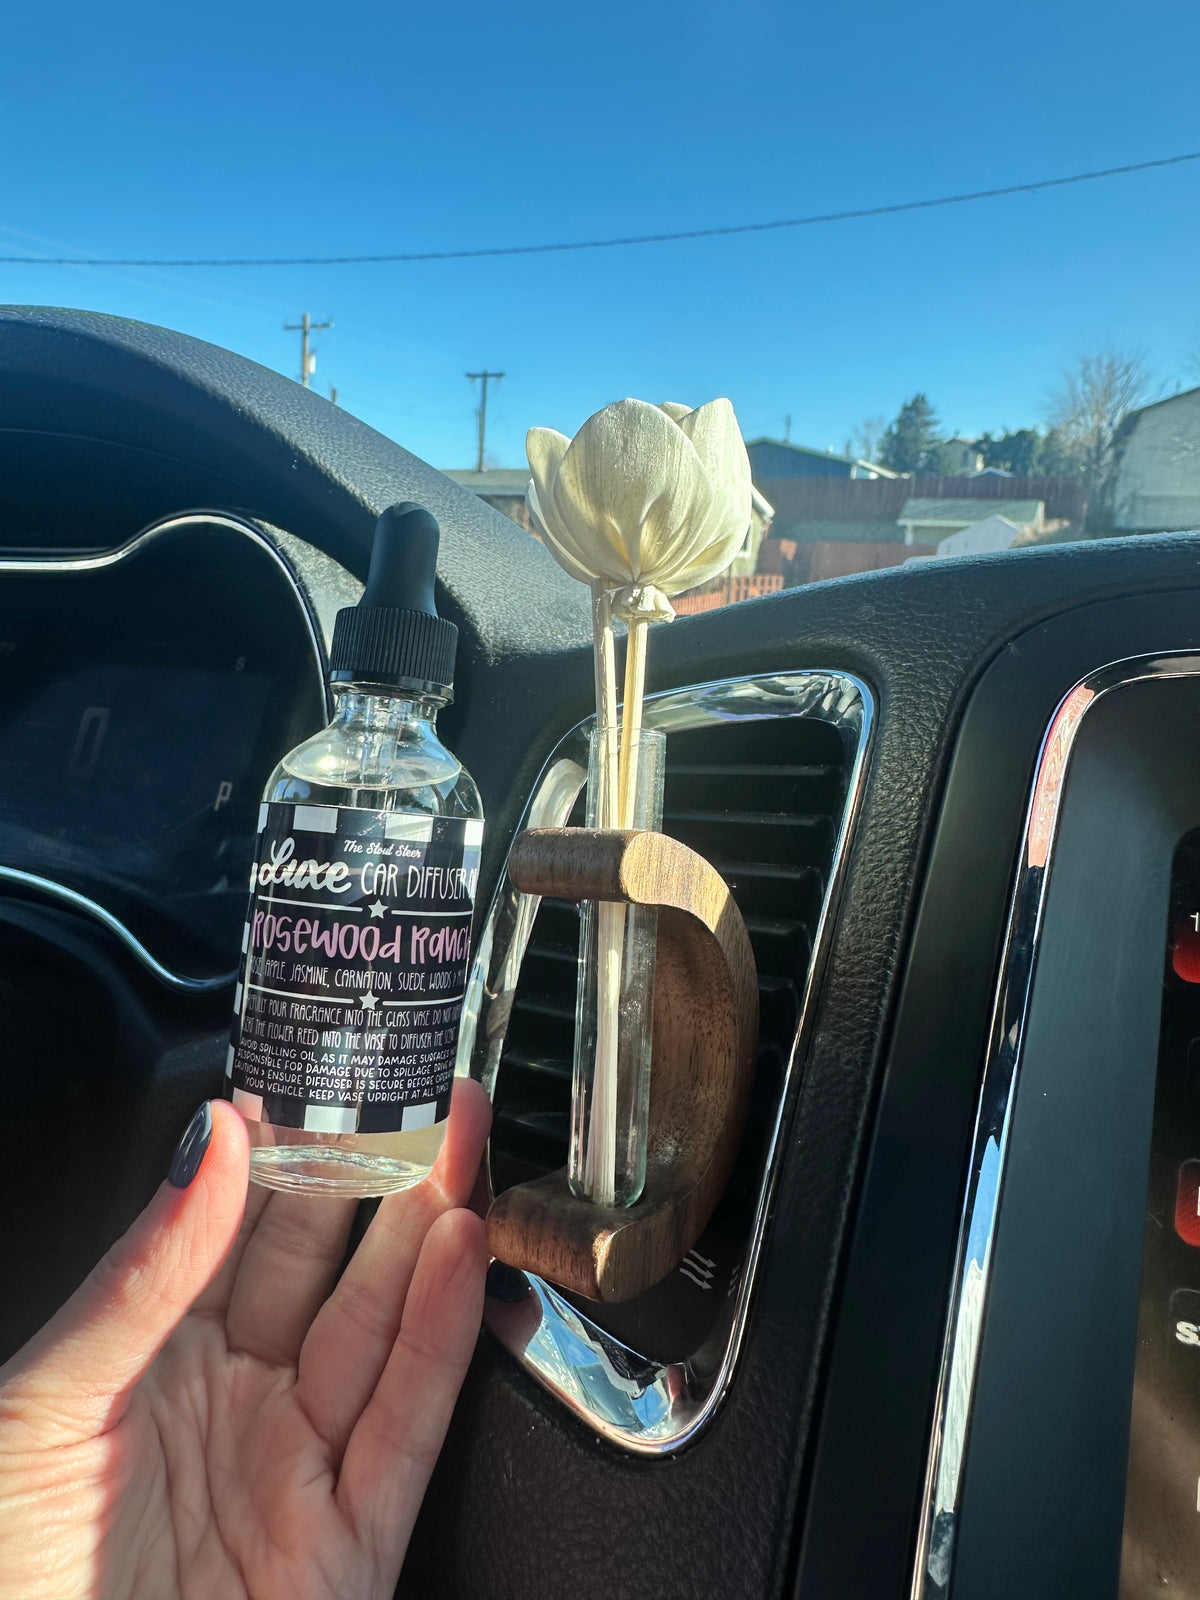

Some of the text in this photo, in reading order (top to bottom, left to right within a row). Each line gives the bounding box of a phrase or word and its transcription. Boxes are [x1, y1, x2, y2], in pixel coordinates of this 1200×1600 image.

[214, 780, 234, 811] P
[343, 839, 421, 858] The Stout Steer
[360, 861, 399, 897] CAR
[406, 865, 467, 899] DIFFUSER
[289, 962, 330, 988] JASMINE,
[334, 968, 394, 993] CARNATION,
[397, 971, 426, 992] SUEDE,
[269, 999, 287, 1018] POUR
[289, 1002, 342, 1025] FRAGRANCE
[344, 1009, 364, 1025] INTO
[367, 1009, 383, 1027] THE
[386, 1010, 410, 1027] GLASS
[413, 1009, 431, 1026] VASE
[267, 1021, 294, 1042] FLOWER
[297, 1027, 319, 1046] REED
[321, 1030, 341, 1048] INTO
[345, 1031, 361, 1049] THE
[364, 1033, 386, 1050] VASE
[388, 1033, 398, 1050] TO
[238, 1047, 282, 1069] RESPONSIBLE
[284, 1060, 303, 1072] FOR
[306, 1063, 351, 1077] DAMAGE
[354, 1066, 374, 1078] DUE
[378, 1067, 391, 1078] TO
[393, 1064, 431, 1077] SPILLAGE
[259, 1042, 297, 1059] SPILLING
[300, 1050, 318, 1063] OIL,
[321, 1053, 335, 1063] AS
[338, 1054, 349, 1064] IT
[350, 1055, 375, 1066] MAY
[378, 1054, 418, 1066] DAMAGE
[234, 1059, 259, 1076] CAUTION
[267, 1069, 303, 1085] ENSURE
[305, 1075, 353, 1089] DIFFUSER
[356, 1079, 366, 1090] IS
[368, 1079, 404, 1090] SECURE
[407, 1075, 434, 1089] BEFORE
[245, 1075, 264, 1089] YOUR
[308, 1089, 335, 1101] KEEP
[337, 1091, 364, 1102] VASE
[367, 1091, 409, 1102] UPRIGHT
[411, 1089, 421, 1100] AT
[422, 1087, 434, 1097] ALL
[1176, 1320, 1200, 1345] S
